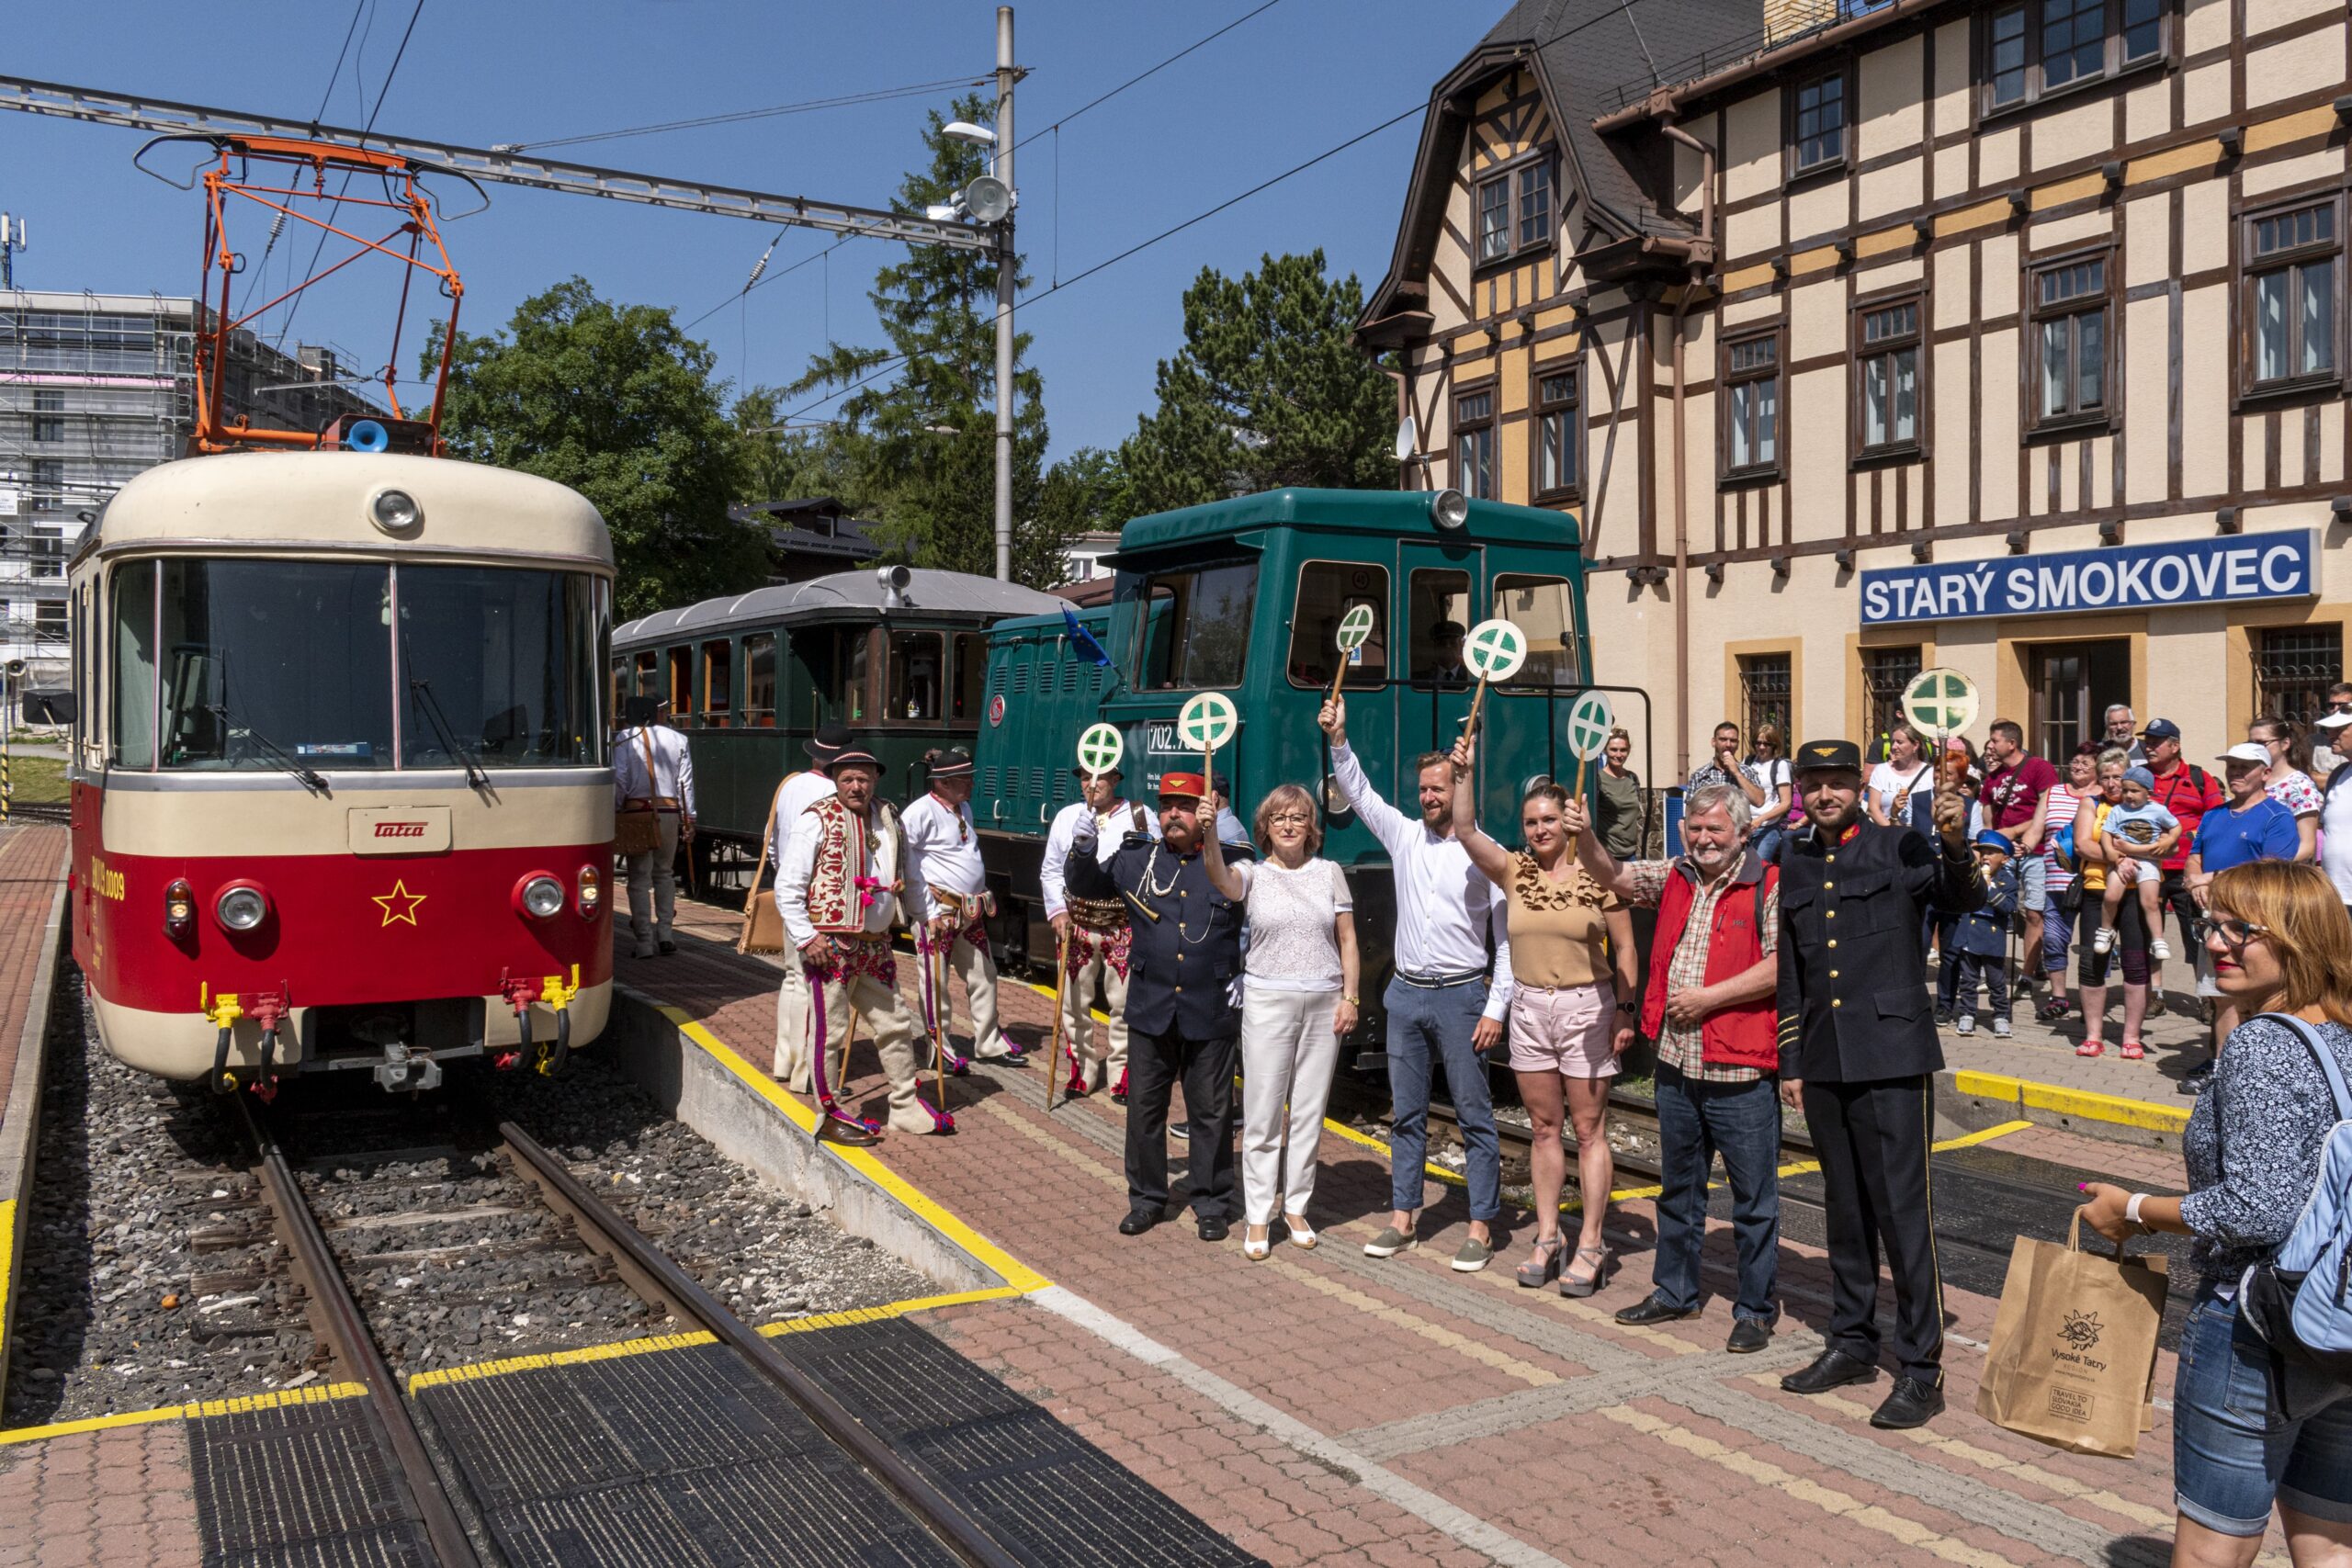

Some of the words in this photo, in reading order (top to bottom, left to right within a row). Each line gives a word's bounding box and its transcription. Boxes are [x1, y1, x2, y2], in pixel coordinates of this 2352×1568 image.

[1865, 562, 1996, 620] STARÝ
[2007, 546, 2301, 610] SMOKOVEC
[375, 821, 428, 838] Tatra
[2052, 1348, 2081, 1362] Vysoké
[2083, 1355, 2107, 1371] Tatry
[2052, 1396, 2081, 1407] SLOVAKIA
[2053, 1389, 2076, 1401] TRAVEL
[2077, 1394, 2087, 1403] TO
[2051, 1403, 2071, 1412] GOOD
[2072, 1408, 2086, 1416] IDEA
